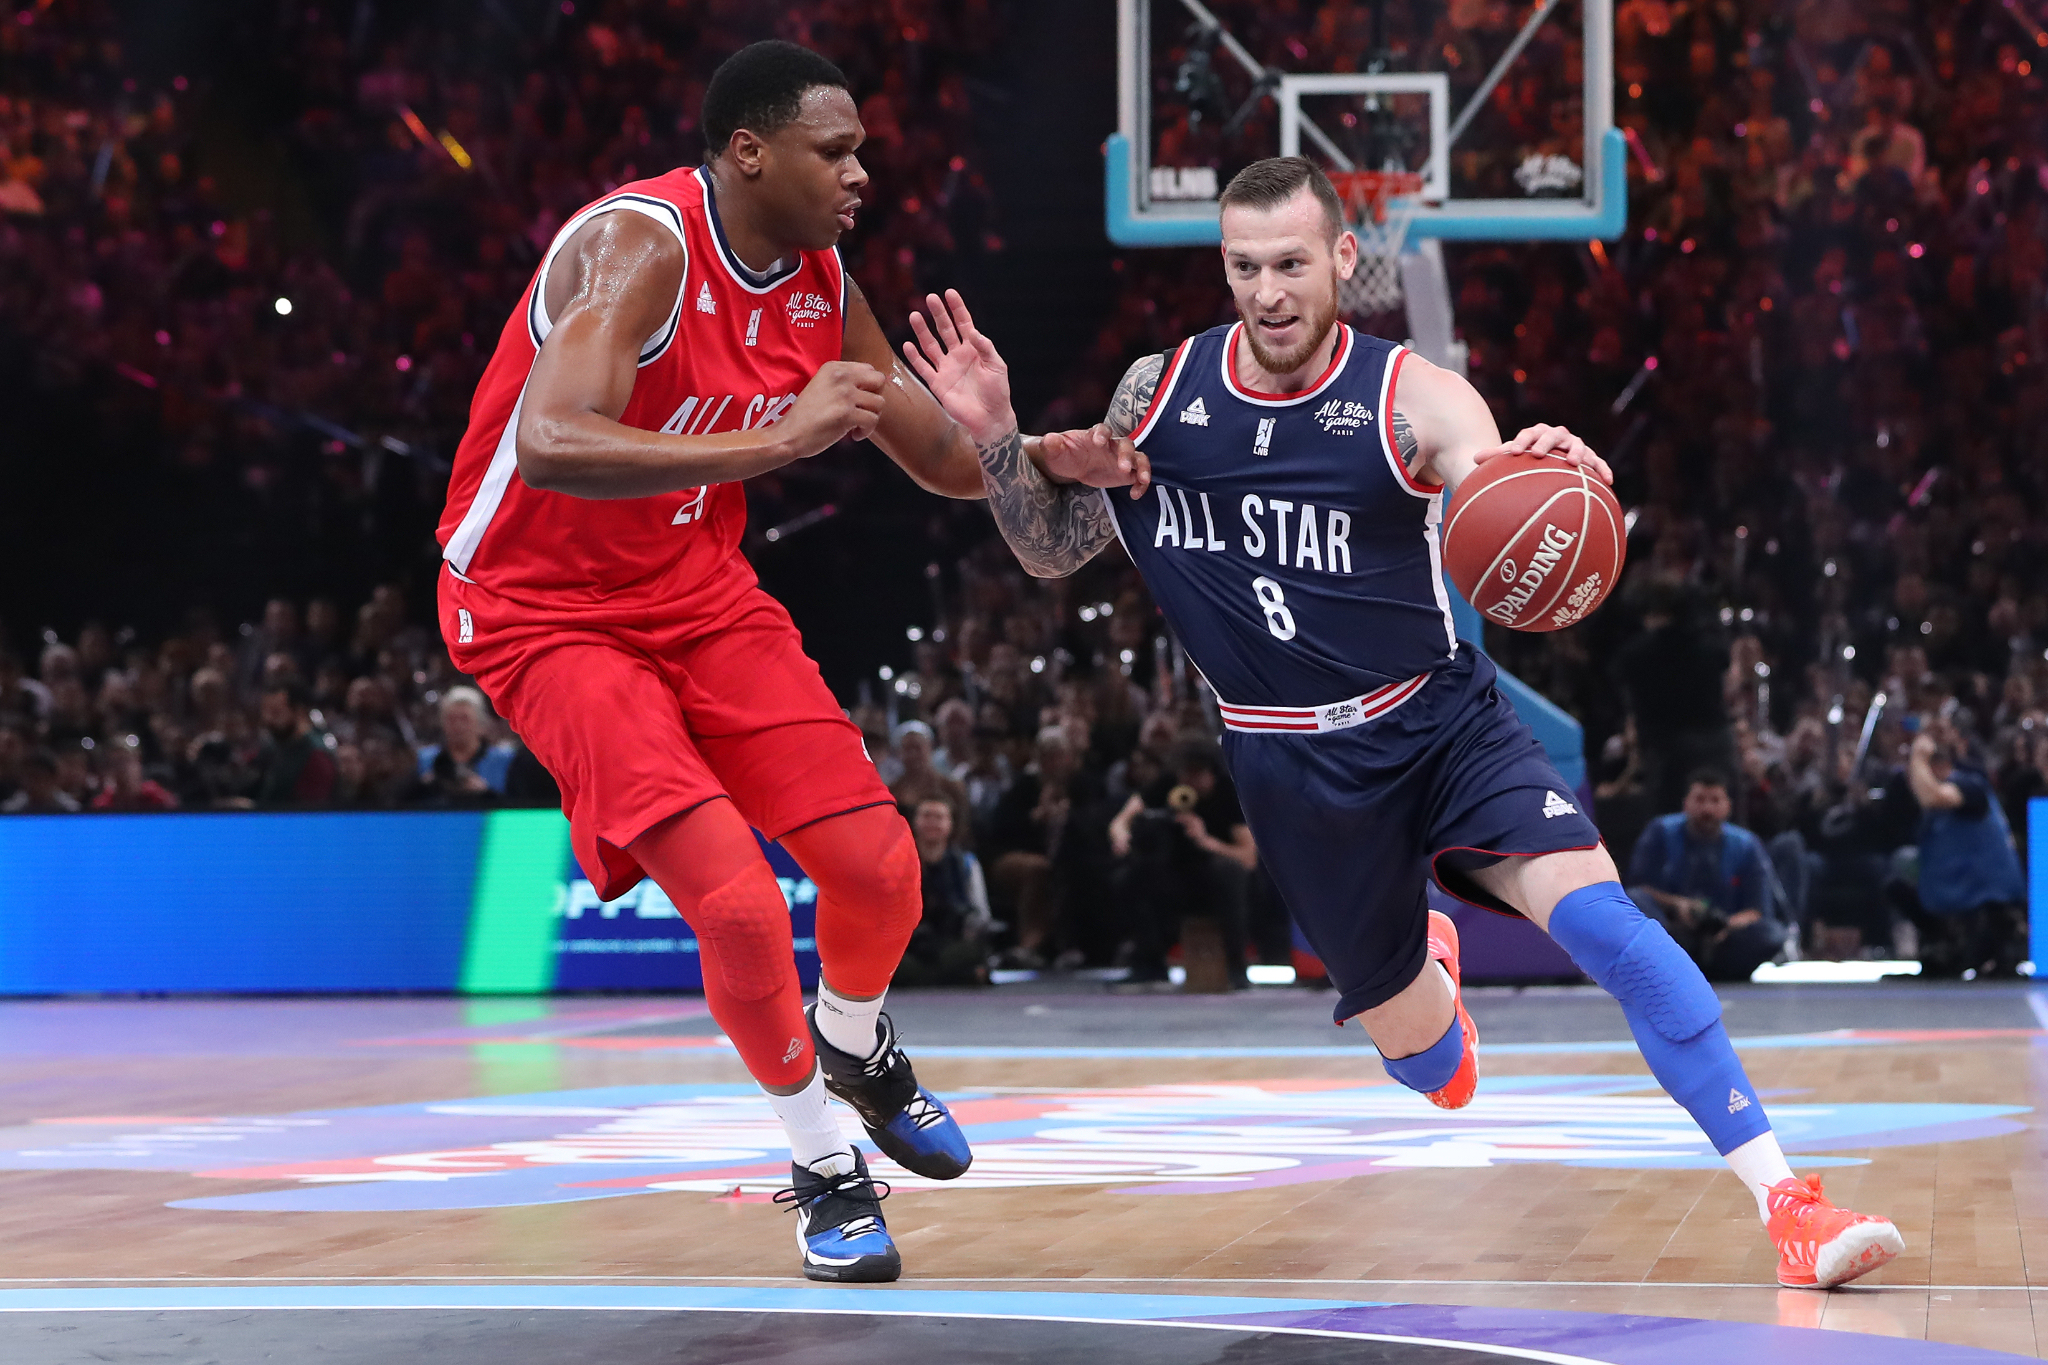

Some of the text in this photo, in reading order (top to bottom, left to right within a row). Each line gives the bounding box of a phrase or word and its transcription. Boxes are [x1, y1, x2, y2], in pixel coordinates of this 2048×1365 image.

[786, 291, 832, 313] All Star
[790, 309, 821, 325] game
[1314, 399, 1375, 421] All Star
[1323, 416, 1361, 432] game
[1253, 445, 1270, 457] LNB
[1154, 484, 1353, 574] ALL STAR
[1486, 523, 1576, 625] SPALDING
[1252, 575, 1297, 641] 8
[1552, 606, 1577, 627] All
[1567, 571, 1600, 608] Star
[1324, 704, 1358, 719] All Star
[1542, 803, 1578, 819] PEAK
[1726, 1096, 1752, 1115] PEAK
